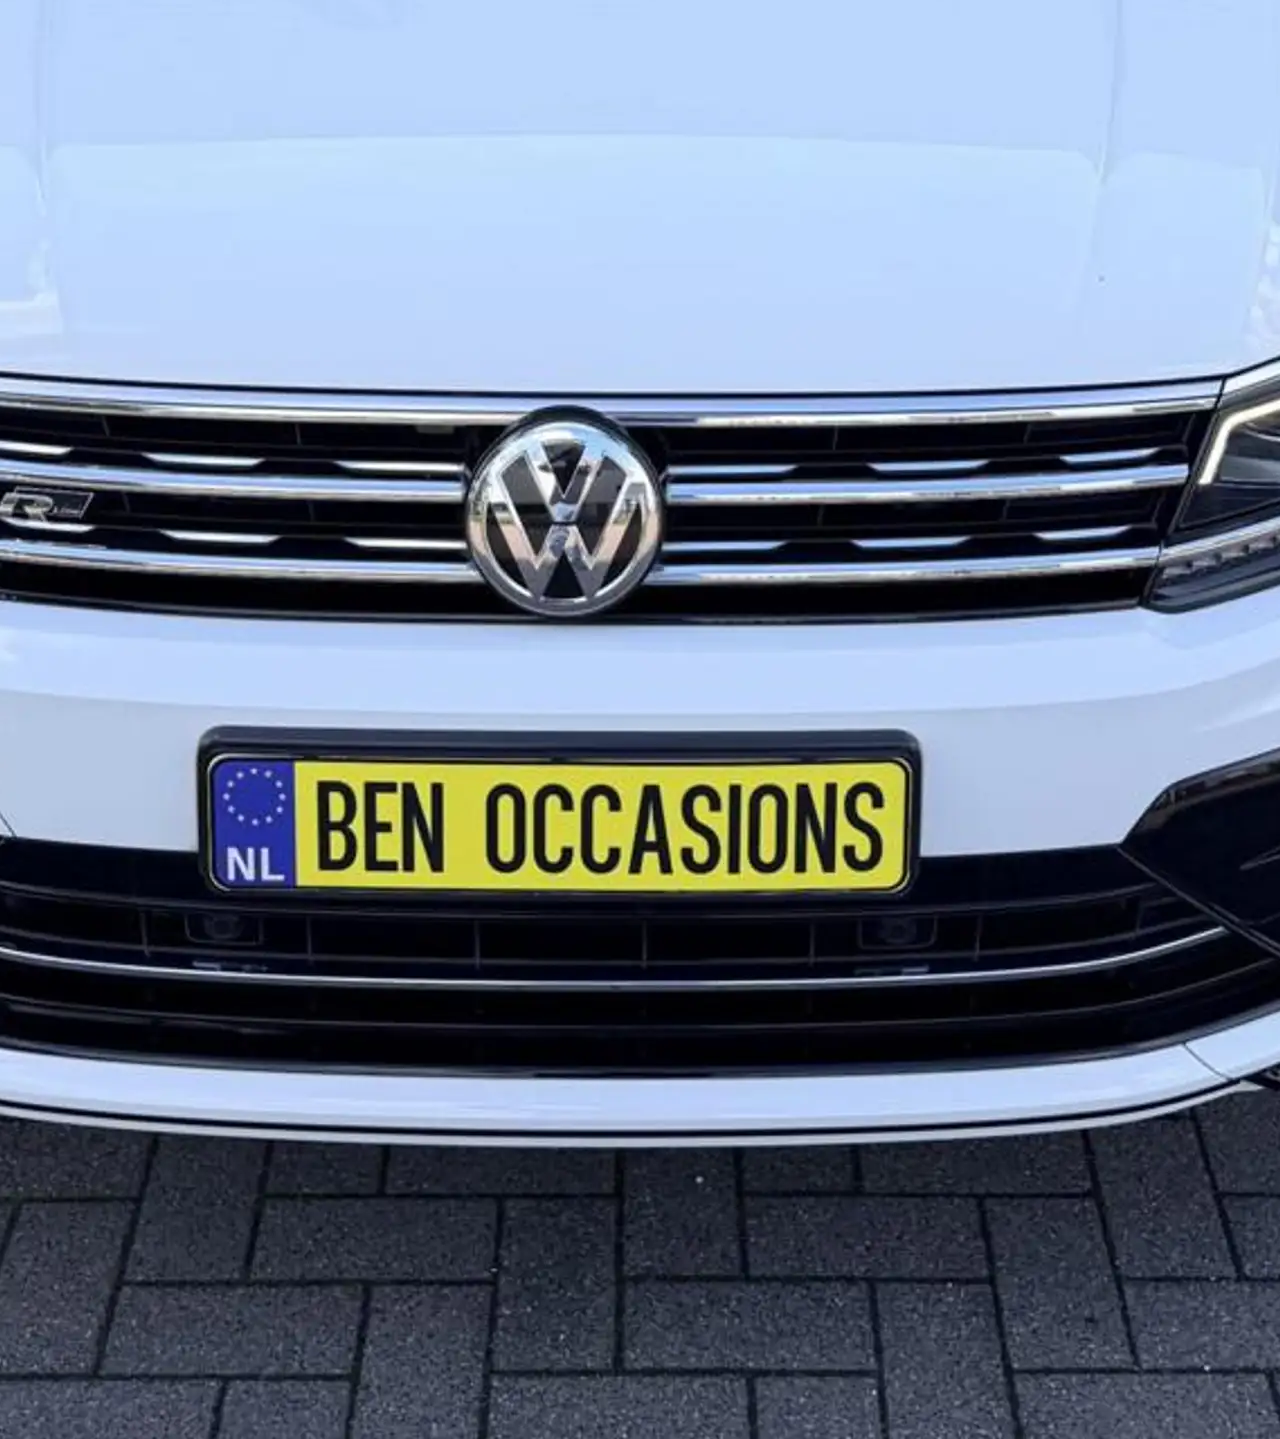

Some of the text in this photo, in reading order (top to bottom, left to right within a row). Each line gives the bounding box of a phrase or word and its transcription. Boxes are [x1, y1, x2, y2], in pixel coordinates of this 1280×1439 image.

[315, 779, 886, 875] BEN OCCASIONS
[225, 845, 287, 883] NL
